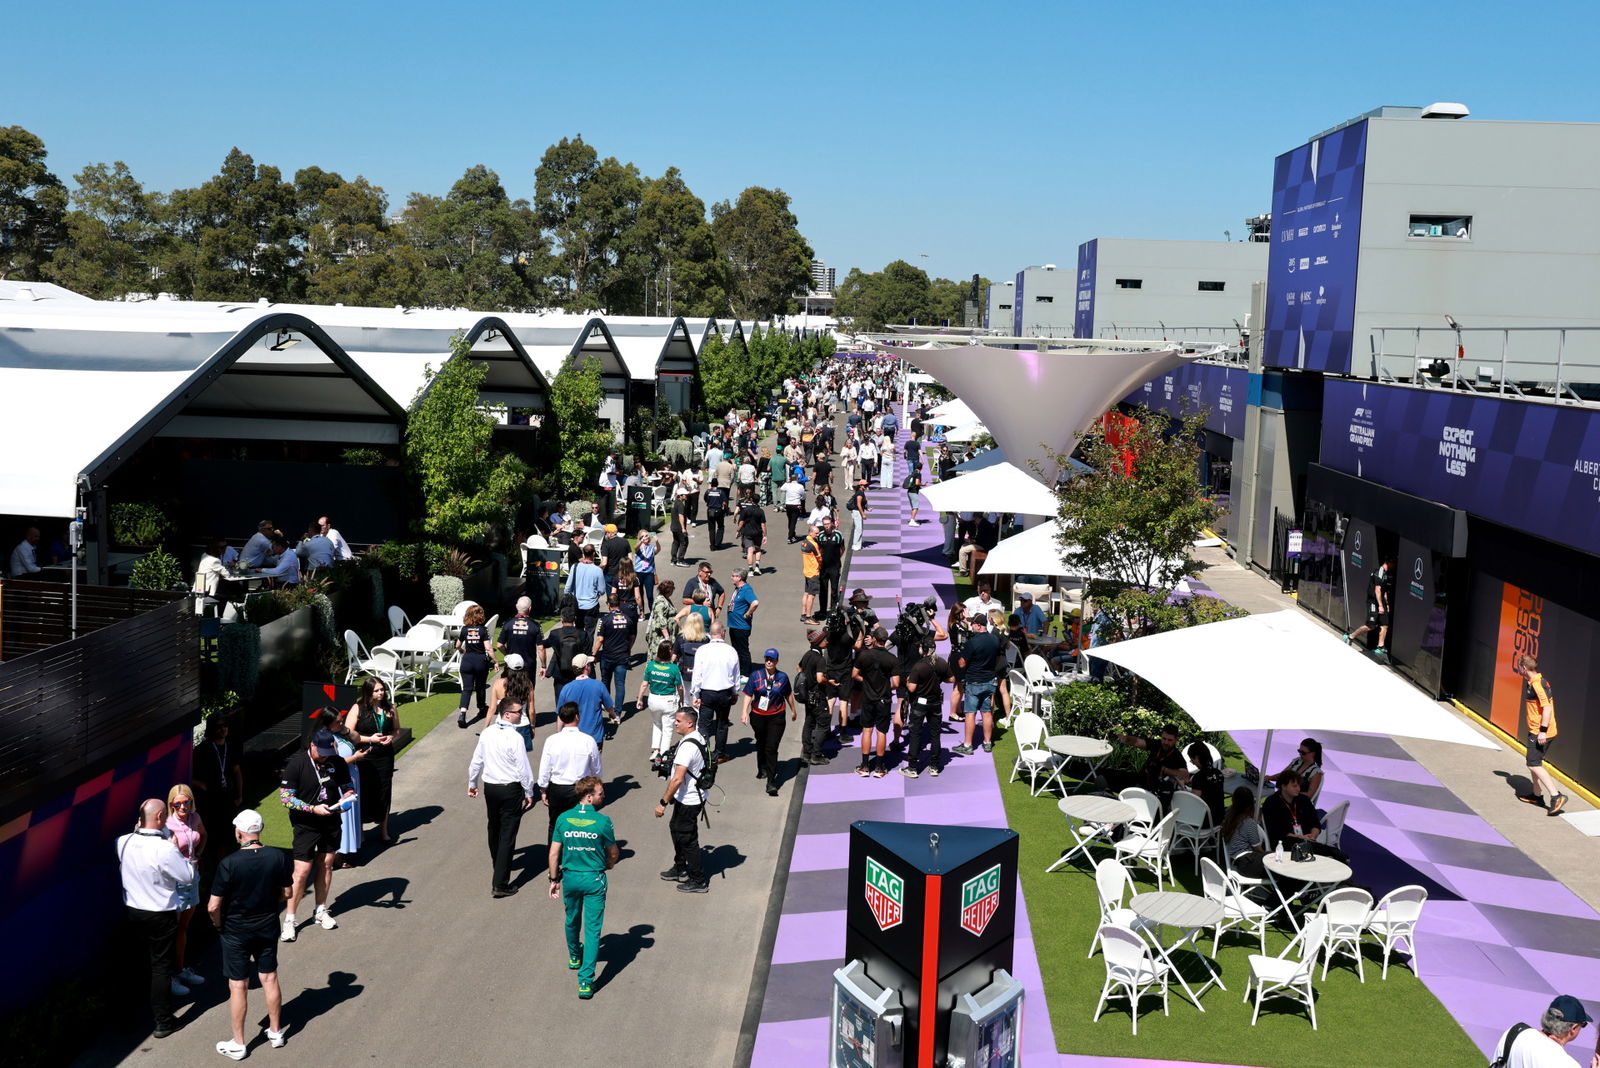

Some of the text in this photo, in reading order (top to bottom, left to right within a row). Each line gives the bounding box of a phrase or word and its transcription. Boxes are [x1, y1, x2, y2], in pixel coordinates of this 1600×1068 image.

[1349, 424, 1375, 438] AUSTRALIAN
[1443, 425, 1474, 445] EXPECT
[1439, 440, 1476, 463] NOTHING
[1446, 458, 1467, 477] LESS
[1574, 459, 1600, 476] ALBER
[564, 831, 598, 839] aramco
[869, 863, 899, 900] TAG
[966, 871, 997, 902] TAG
[867, 886, 900, 925] HEUER
[964, 894, 997, 931] HEUER
